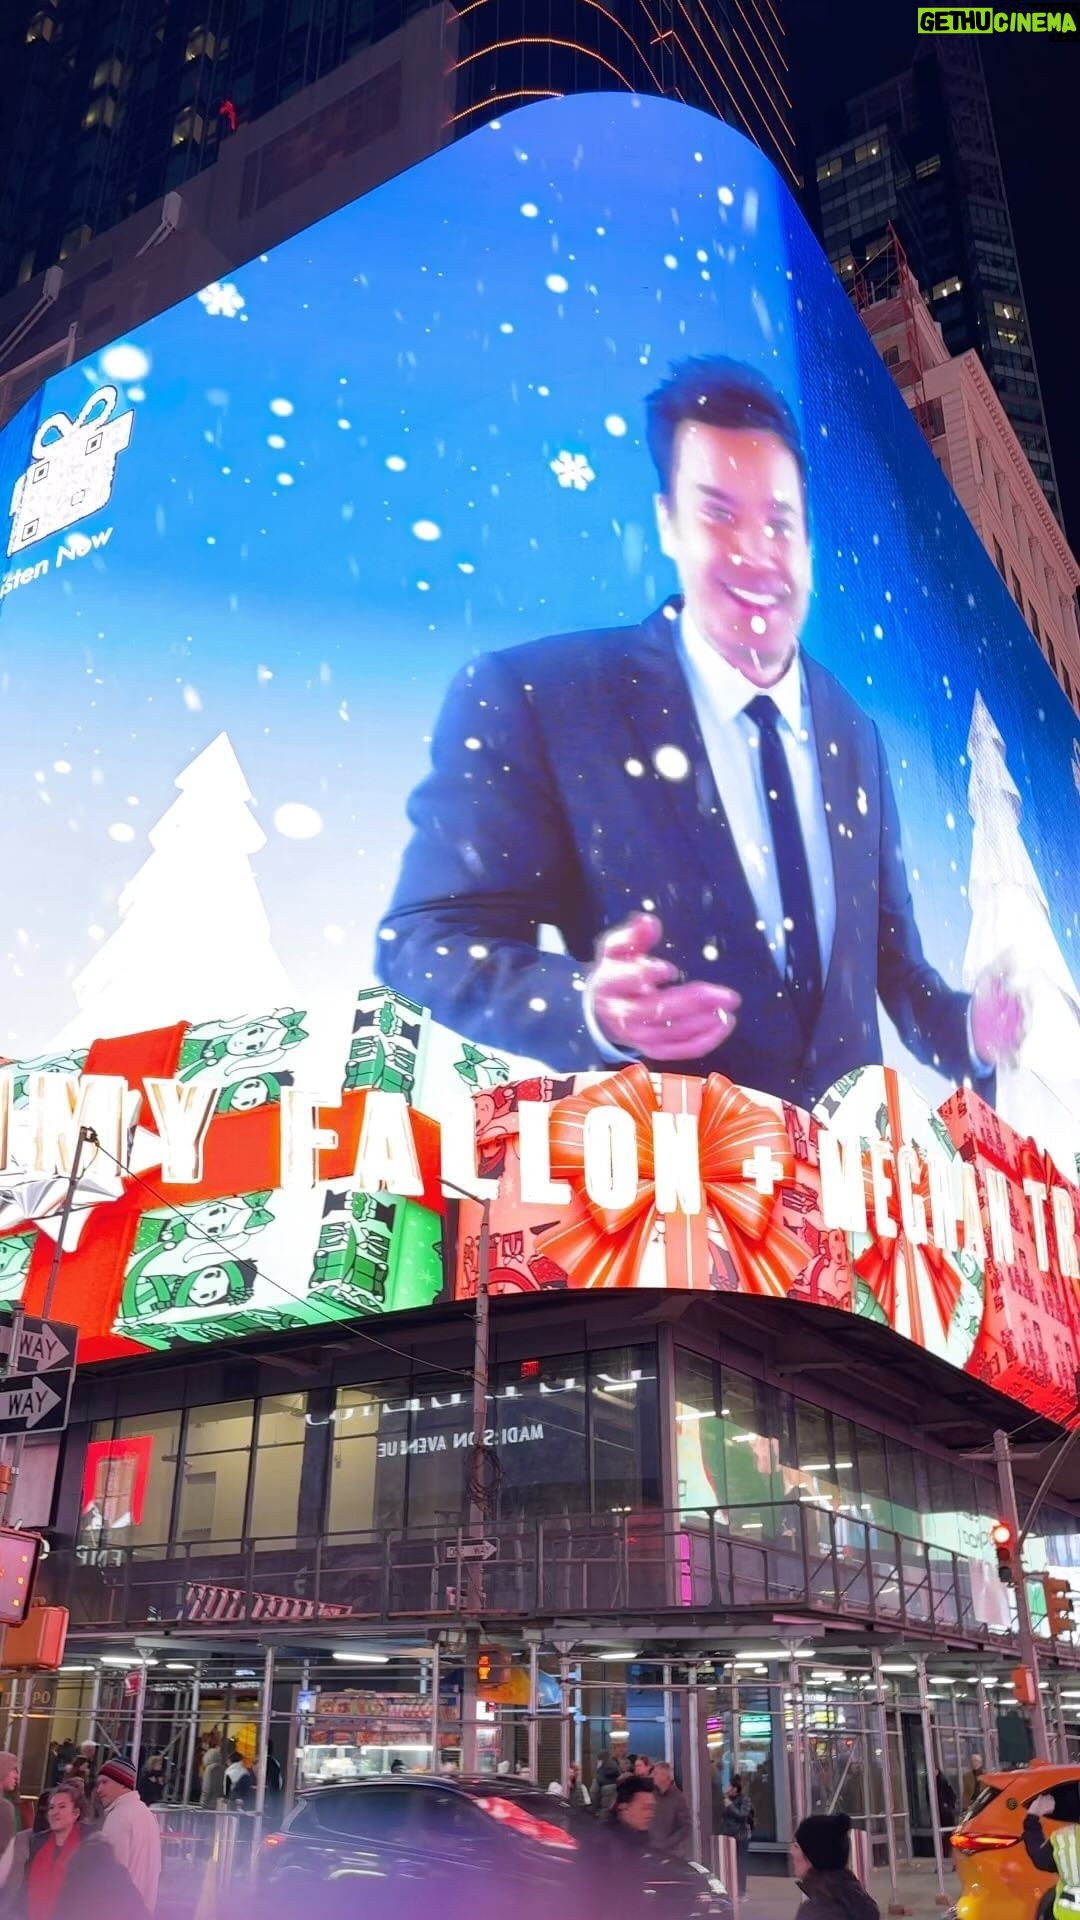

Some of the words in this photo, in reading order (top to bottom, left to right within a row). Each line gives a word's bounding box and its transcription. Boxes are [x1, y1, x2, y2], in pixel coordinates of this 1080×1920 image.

[0, 1073, 222, 1184] MY
[281, 1090, 702, 1214] FALLON
[817, 1130, 1015, 1264] MEGHAN
[20, 1334, 58, 1361] WAY
[8, 1389, 49, 1416] WAY
